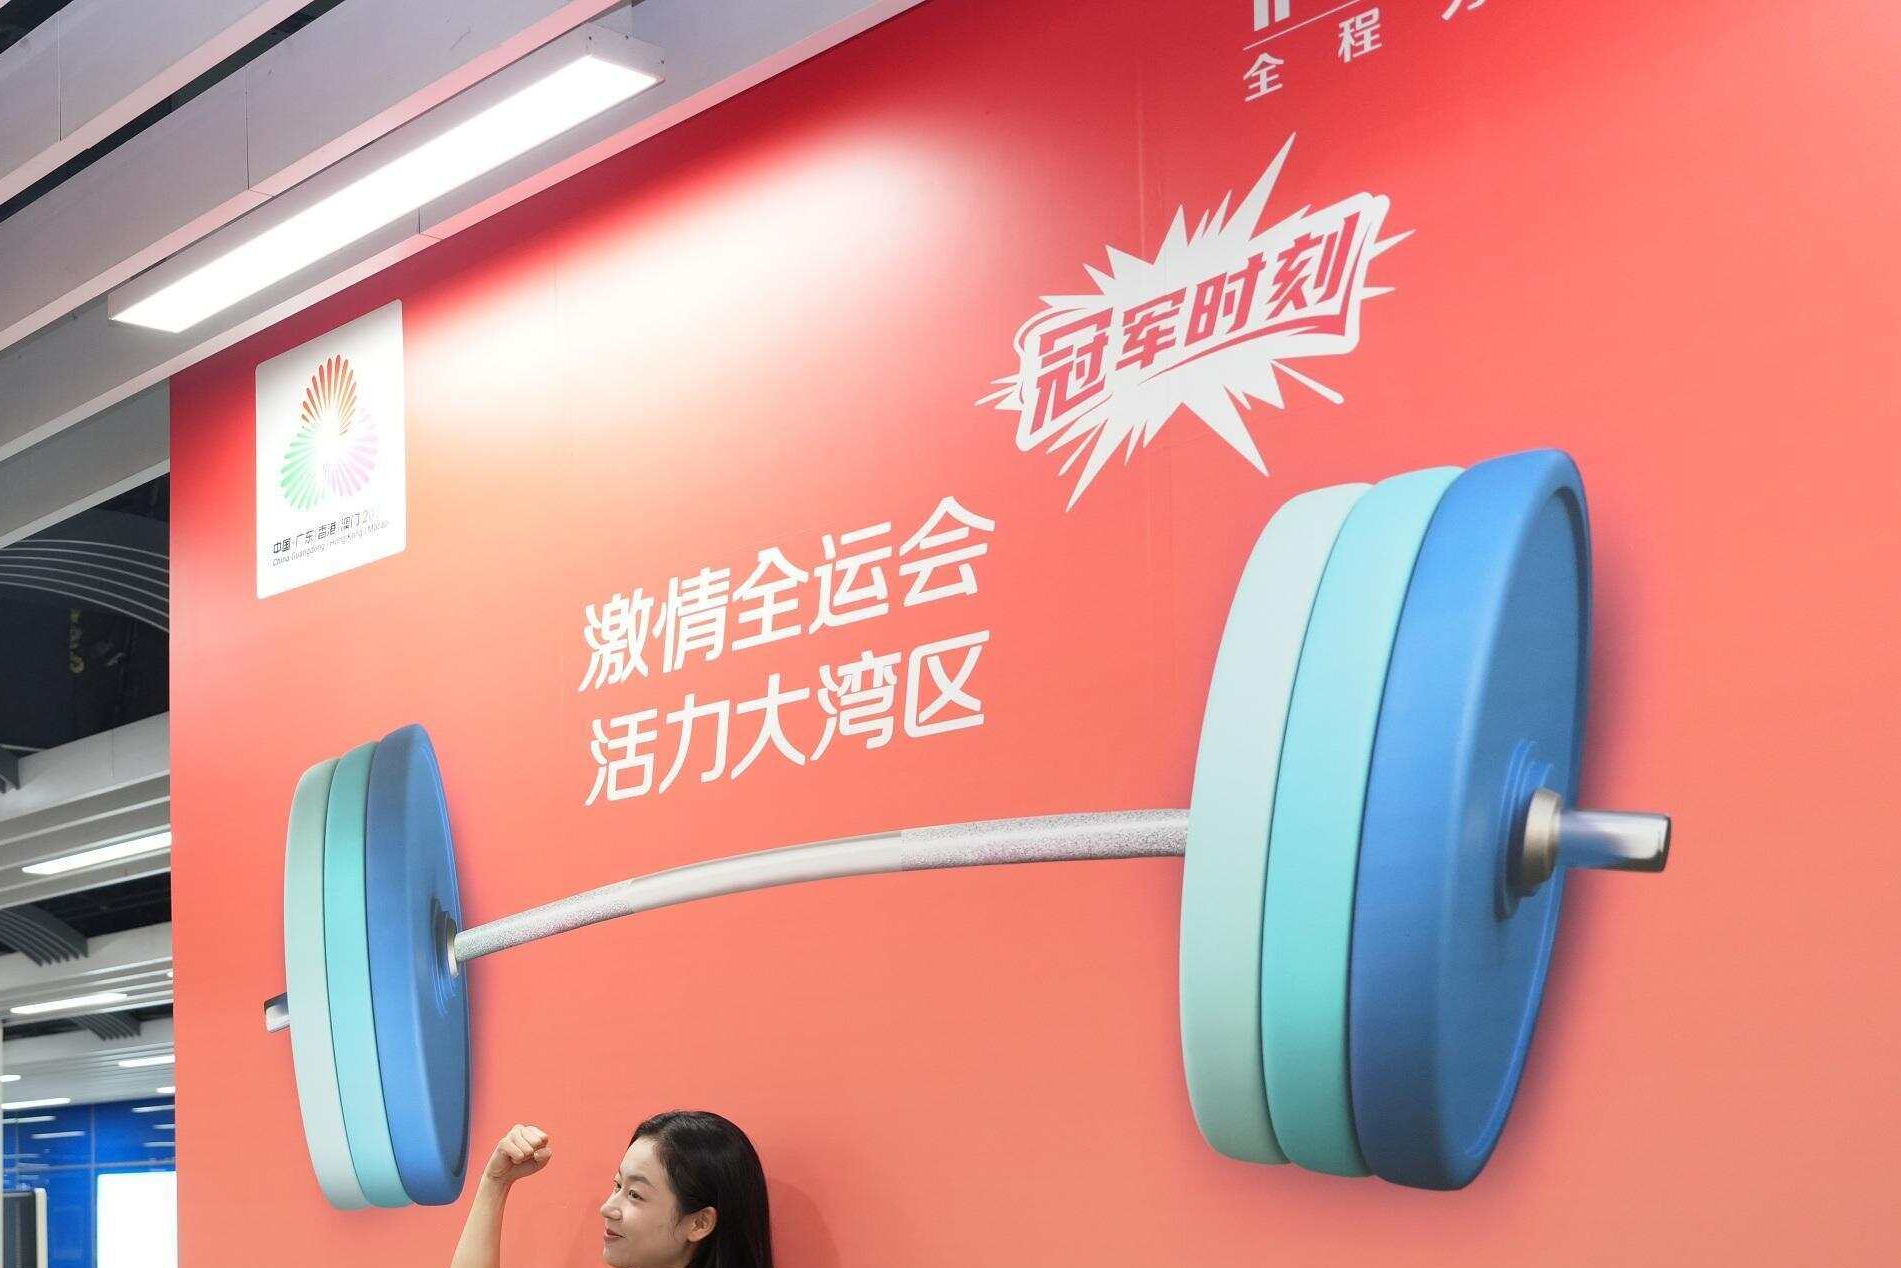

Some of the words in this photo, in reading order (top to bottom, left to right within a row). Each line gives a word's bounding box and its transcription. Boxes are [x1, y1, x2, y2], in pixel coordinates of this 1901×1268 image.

[1028, 210, 1366, 437] 冠军时刻
[578, 495, 996, 693] 激情全运会
[584, 629, 991, 807] 活力大湾区
